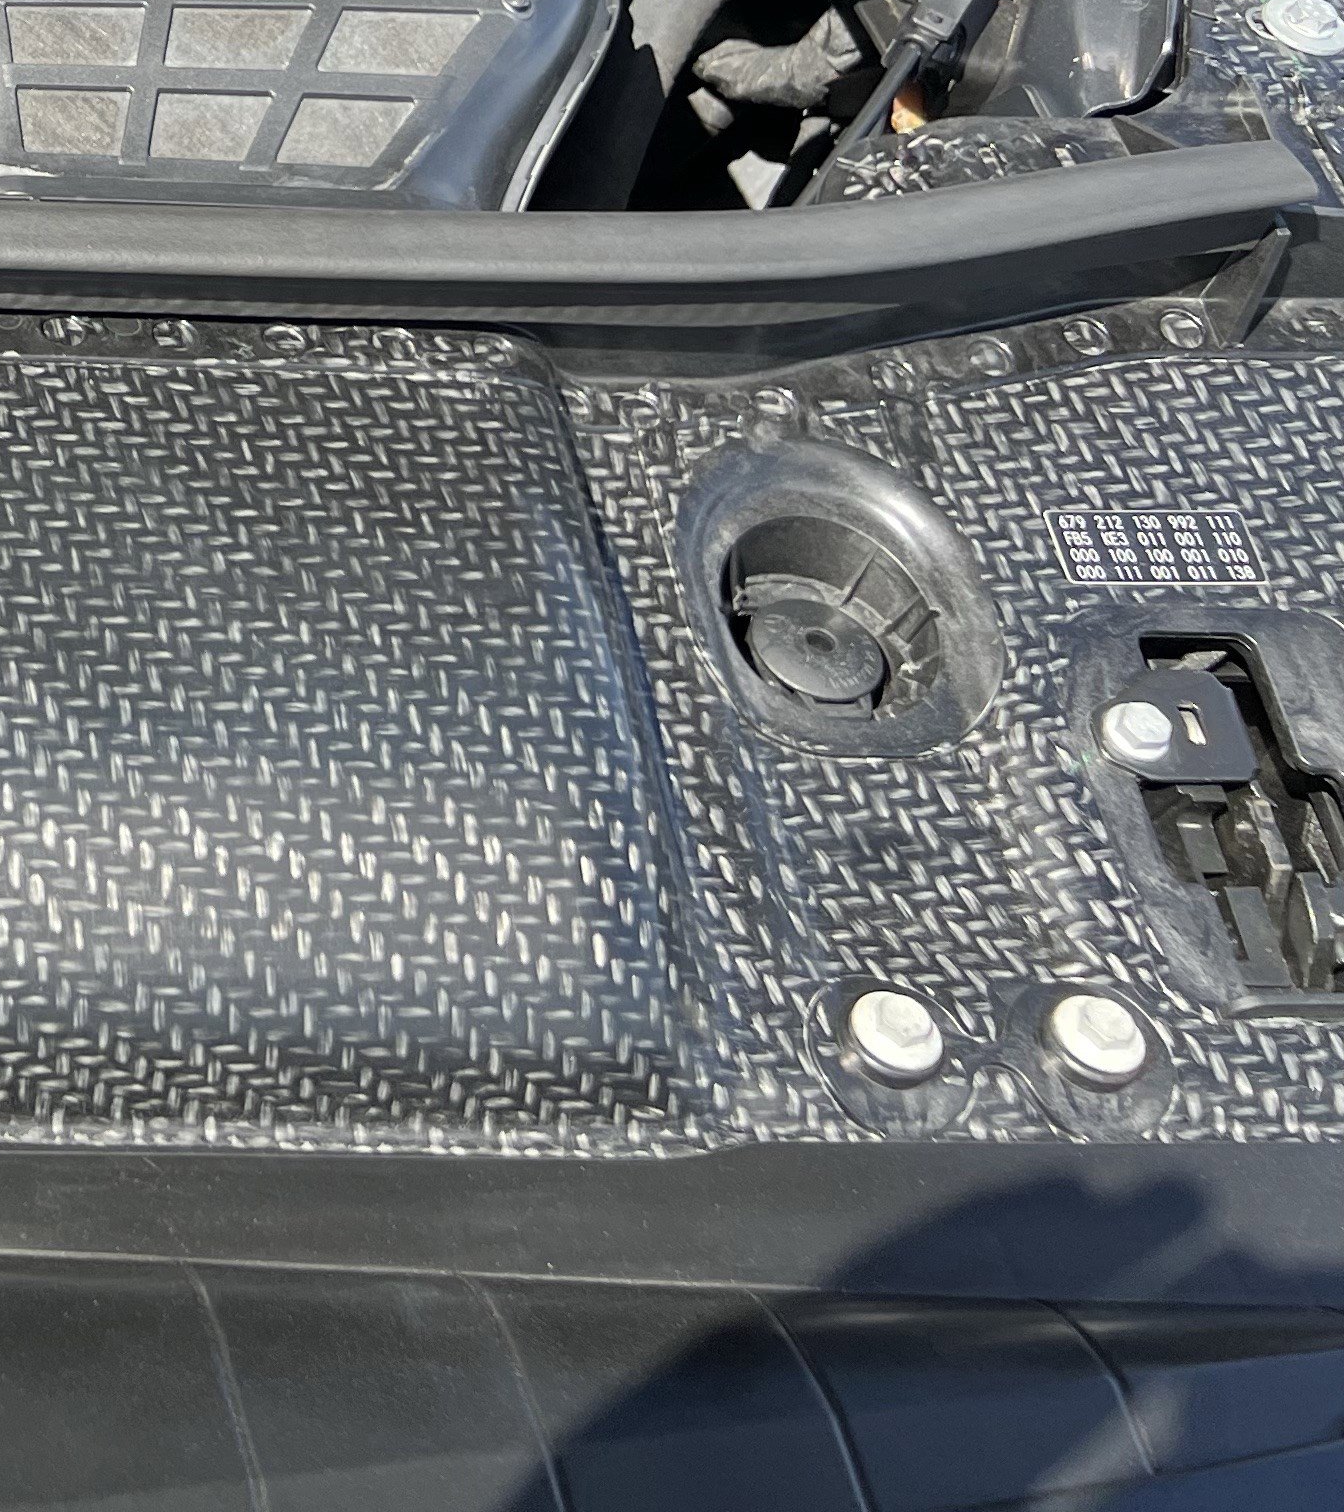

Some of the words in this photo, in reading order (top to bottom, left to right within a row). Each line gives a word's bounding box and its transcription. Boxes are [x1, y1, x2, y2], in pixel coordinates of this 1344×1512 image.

[1058, 514, 1086, 530] 679
[1094, 514, 1124, 530] 212
[1132, 514, 1161, 530] 130
[1167, 514, 1198, 530] 992
[1206, 514, 1234, 530] 111
[1137, 531, 1166, 547] 011
[1174, 531, 1204, 547] 001
[1212, 531, 1242, 547] 110
[1070, 548, 1100, 563] 000
[1108, 548, 1137, 563] 100
[1145, 548, 1174, 563] 100
[1181, 548, 1210, 563] 001
[1218, 548, 1249, 563] 010
[1076, 565, 1106, 580] 000
[1114, 565, 1143, 580] 111
[1150, 565, 1180, 580] 001
[1188, 565, 1217, 580] 011
